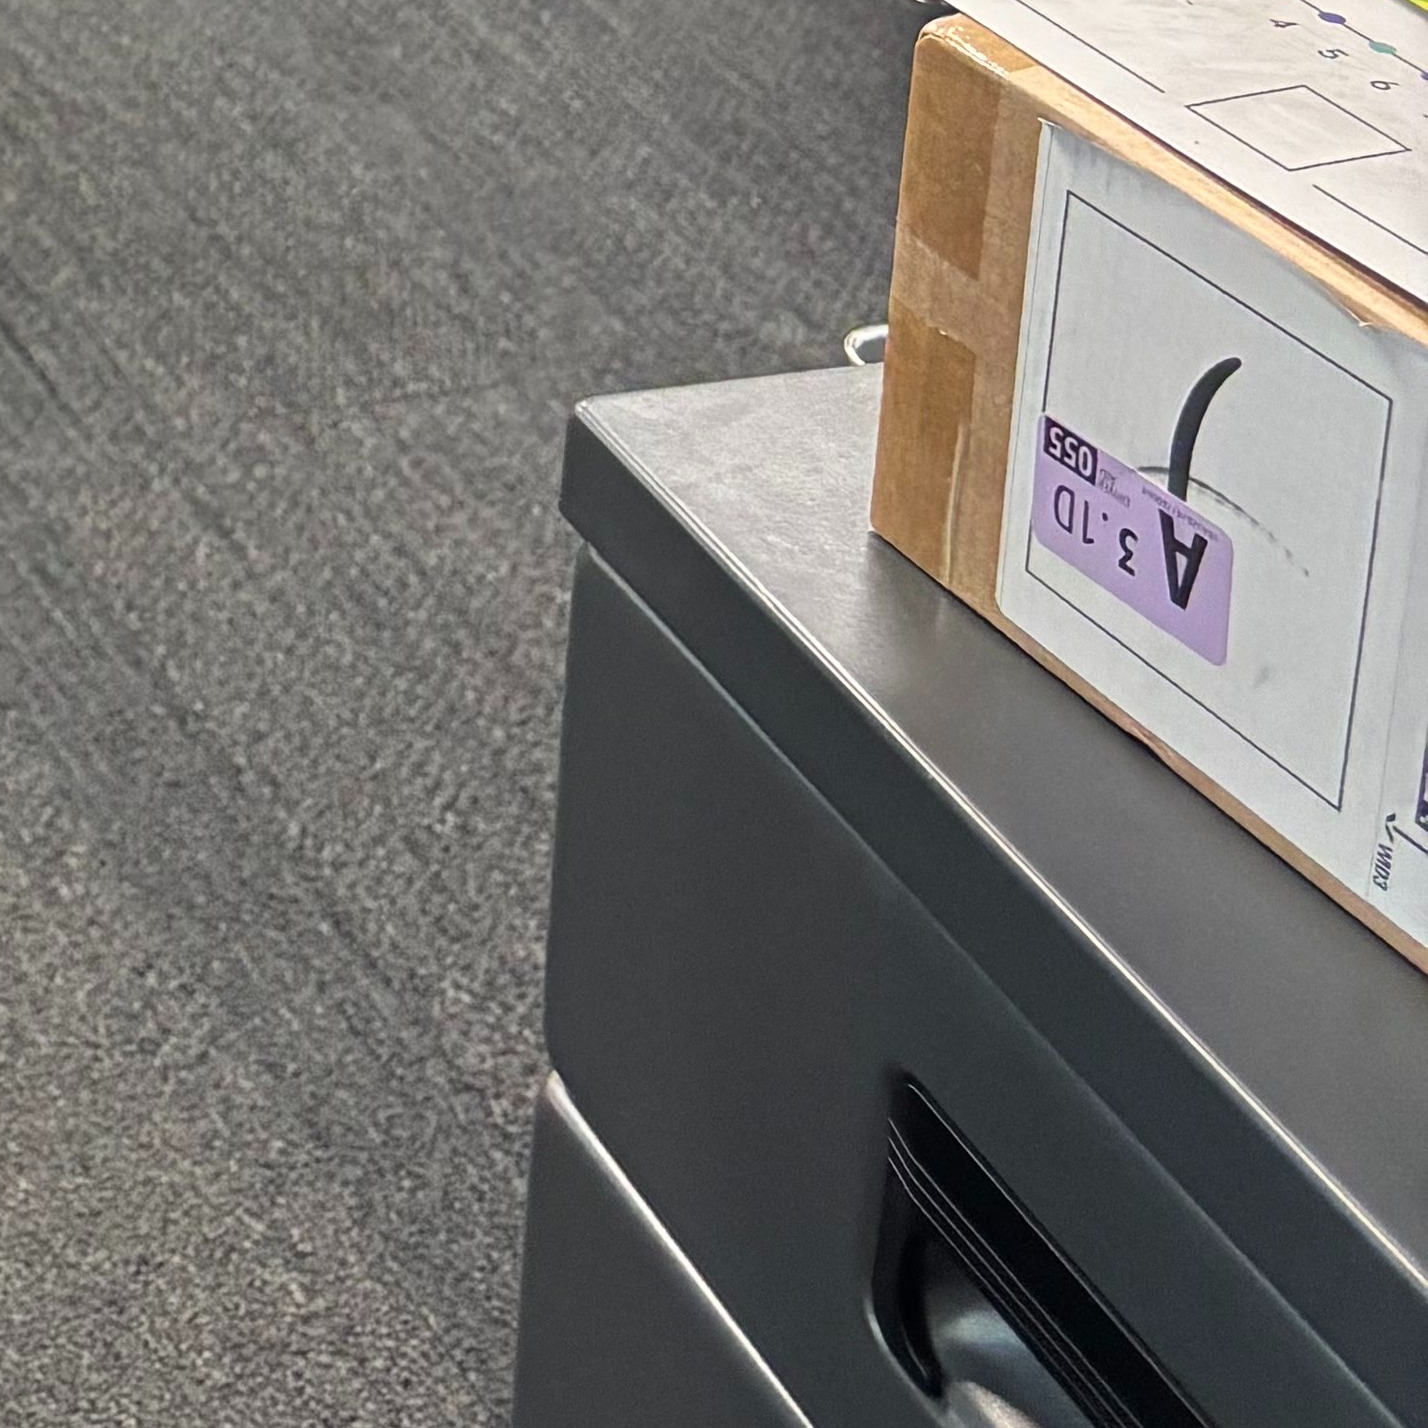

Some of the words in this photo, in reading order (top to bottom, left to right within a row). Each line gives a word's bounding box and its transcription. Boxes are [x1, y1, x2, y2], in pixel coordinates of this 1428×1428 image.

[1268, 18, 1299, 30] 4
[1317, 48, 1350, 60] 5
[1370, 80, 1401, 91] 6
[1048, 425, 1094, 479] 055
[1158, 508, 1209, 611] A
